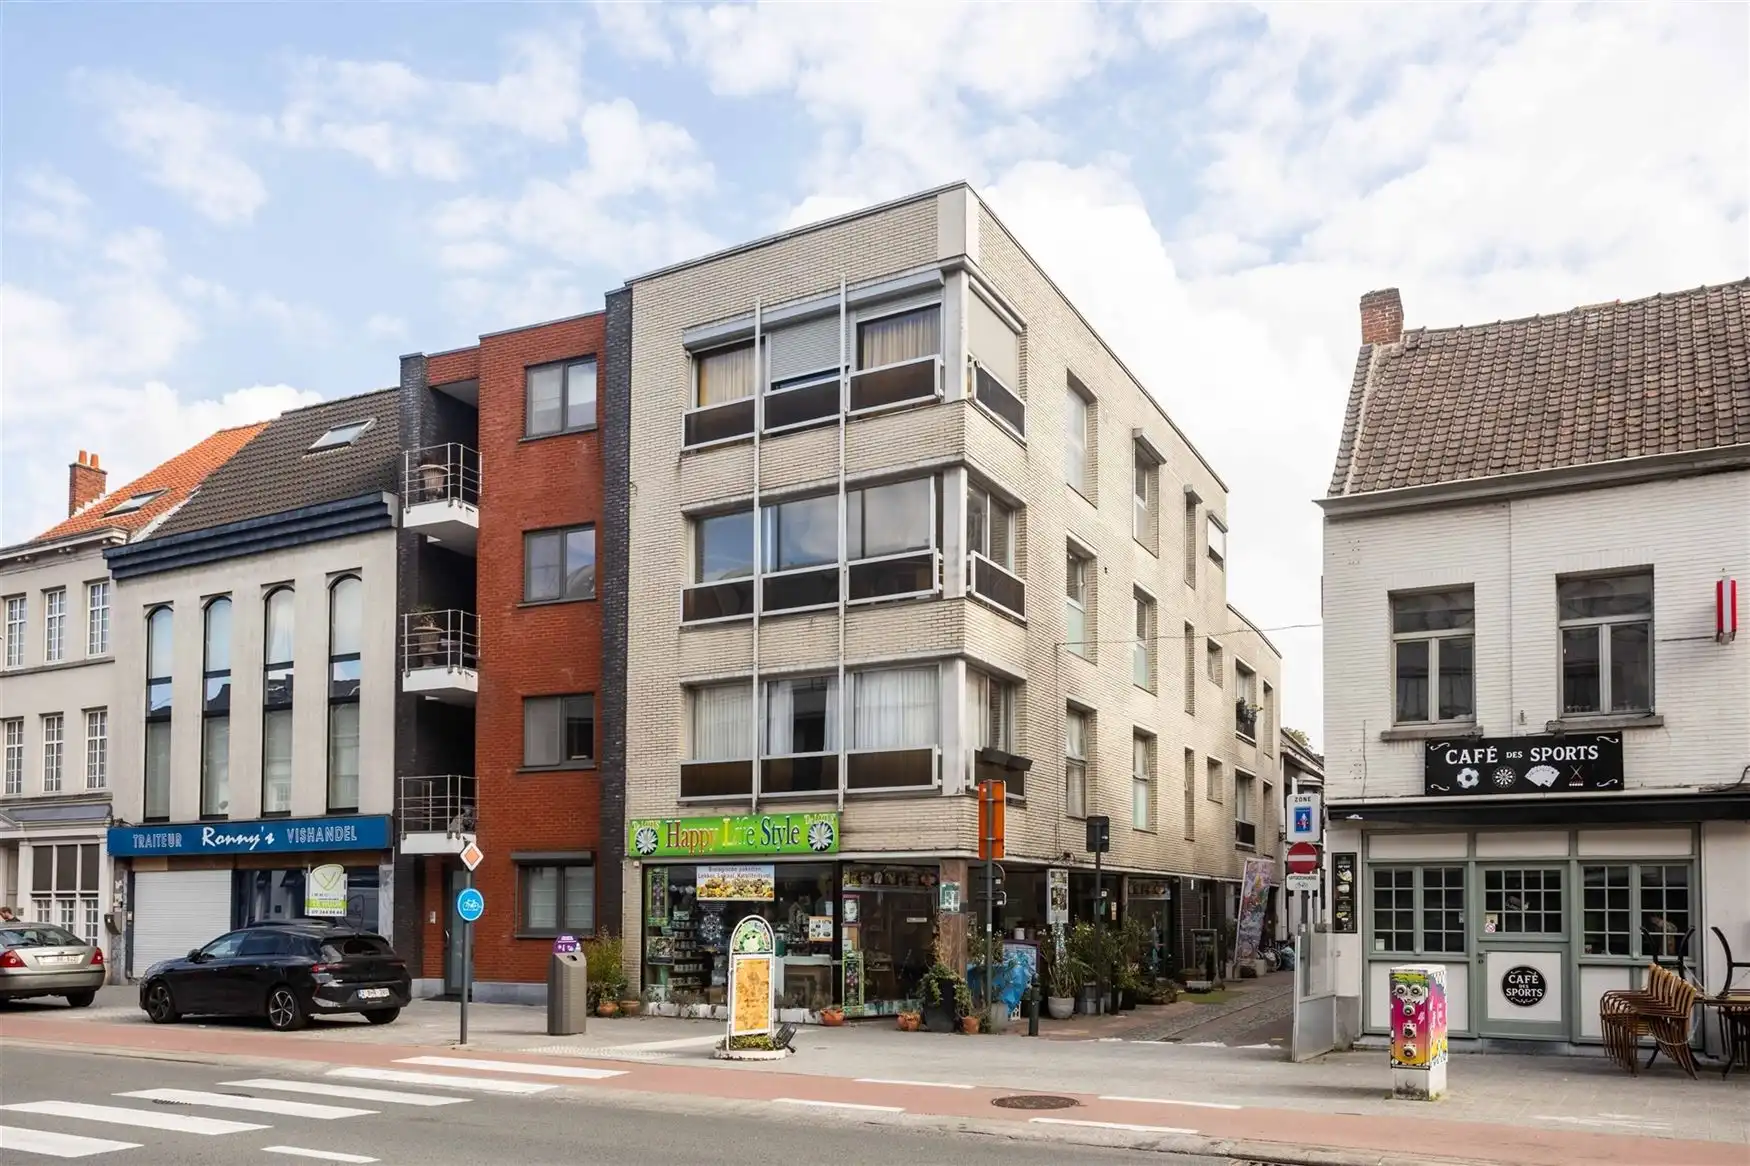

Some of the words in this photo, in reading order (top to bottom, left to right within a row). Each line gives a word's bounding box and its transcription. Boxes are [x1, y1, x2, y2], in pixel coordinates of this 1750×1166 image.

[1445, 746, 1498, 765] CAFÉ
[1506, 751, 1523, 759] DES
[1530, 745, 1599, 762] SPORTS
[132, 832, 182, 849] TRAITEUR
[201, 825, 276, 851] Ronny's
[286, 825, 358, 844] VISHANDEL
[665, 819, 719, 855] Happy
[722, 816, 755, 847] Life
[760, 815, 801, 852] Style
[1508, 973, 1539, 984] CAFÉ
[1505, 988, 1543, 997] SPORTS
